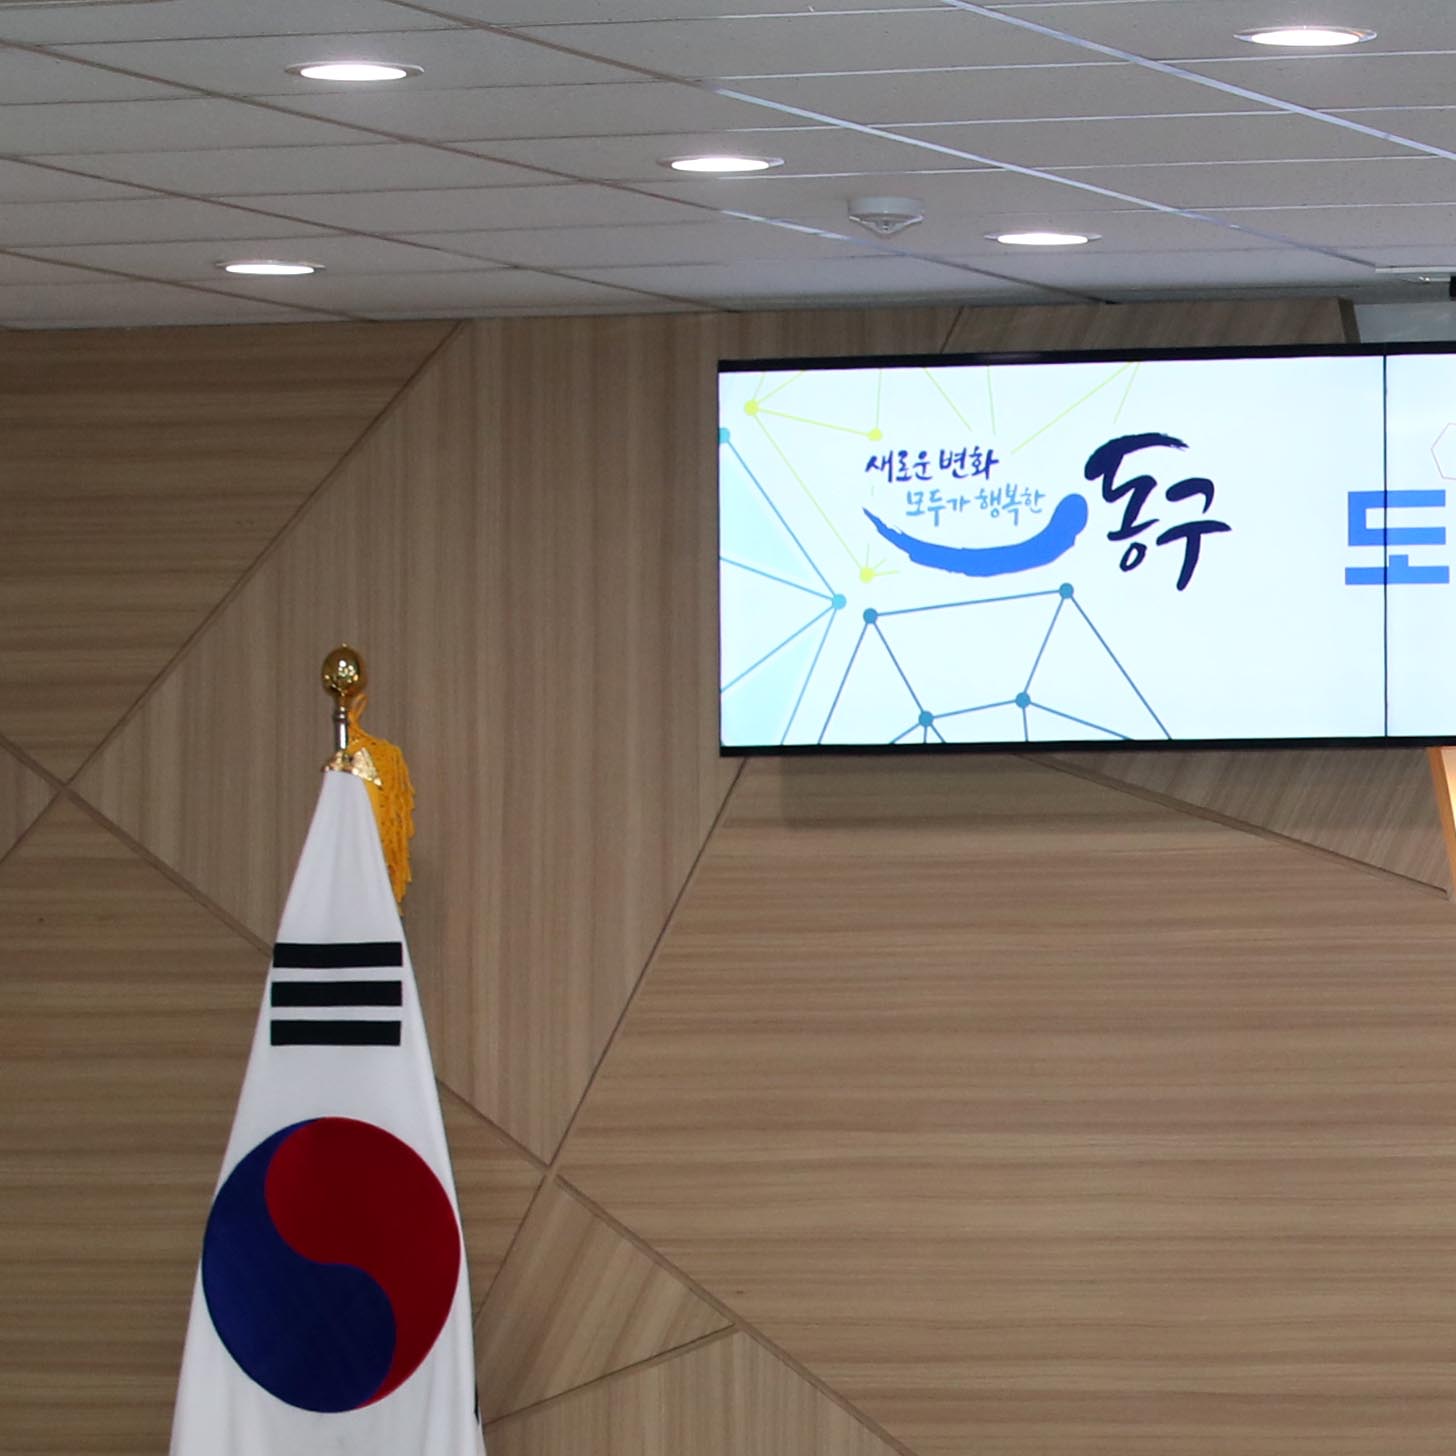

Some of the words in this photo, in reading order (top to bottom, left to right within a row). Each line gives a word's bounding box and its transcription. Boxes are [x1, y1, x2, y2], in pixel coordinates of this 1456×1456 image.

[865, 450, 932, 483] 새로운
[939, 446, 999, 480] 변화
[906, 489, 970, 526] 모두가
[976, 484, 1046, 526] 행복한
[1084, 432, 1232, 591] 동구
